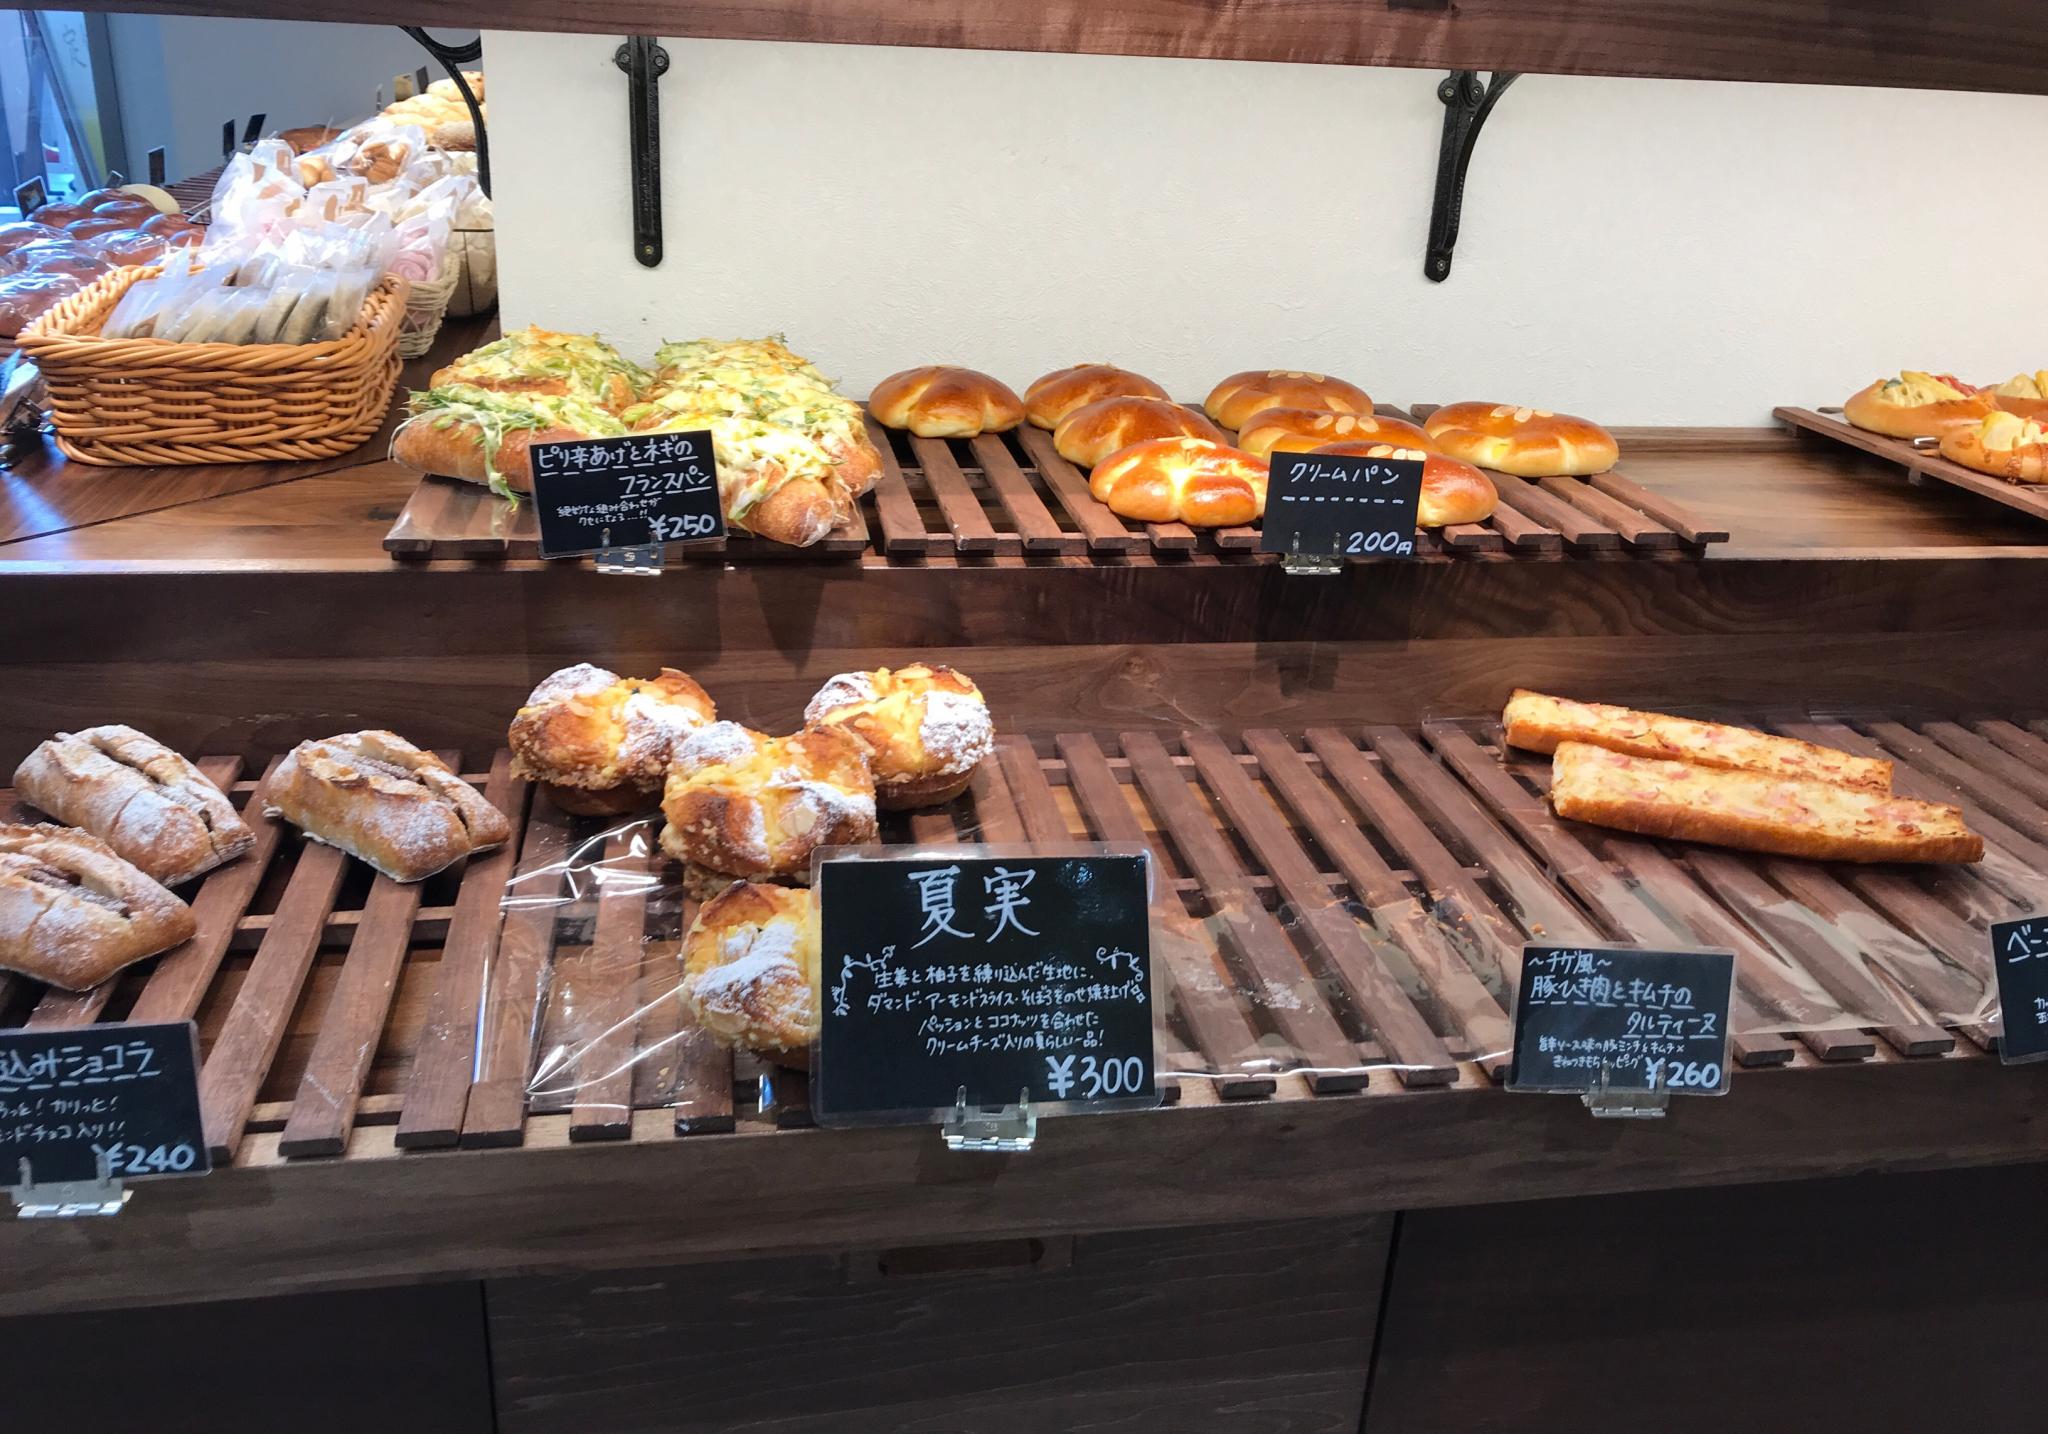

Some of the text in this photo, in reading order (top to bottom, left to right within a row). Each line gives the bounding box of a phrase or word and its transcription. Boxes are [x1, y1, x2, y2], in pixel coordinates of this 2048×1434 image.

[619, 465, 712, 495] フランスパン
[1289, 463, 1400, 485] クリームパン
[648, 513, 716, 542] ¥250
[1346, 531, 1413, 555] 200円
[908, 864, 1041, 950] 夏実
[2007, 924, 2048, 954] ベー
[1626, 1012, 1718, 1036] タルティーヌ
[1045, 1054, 1145, 1098] ¥300
[1645, 1057, 1722, 1090] ¥260
[91, 1140, 197, 1177] ¥240
